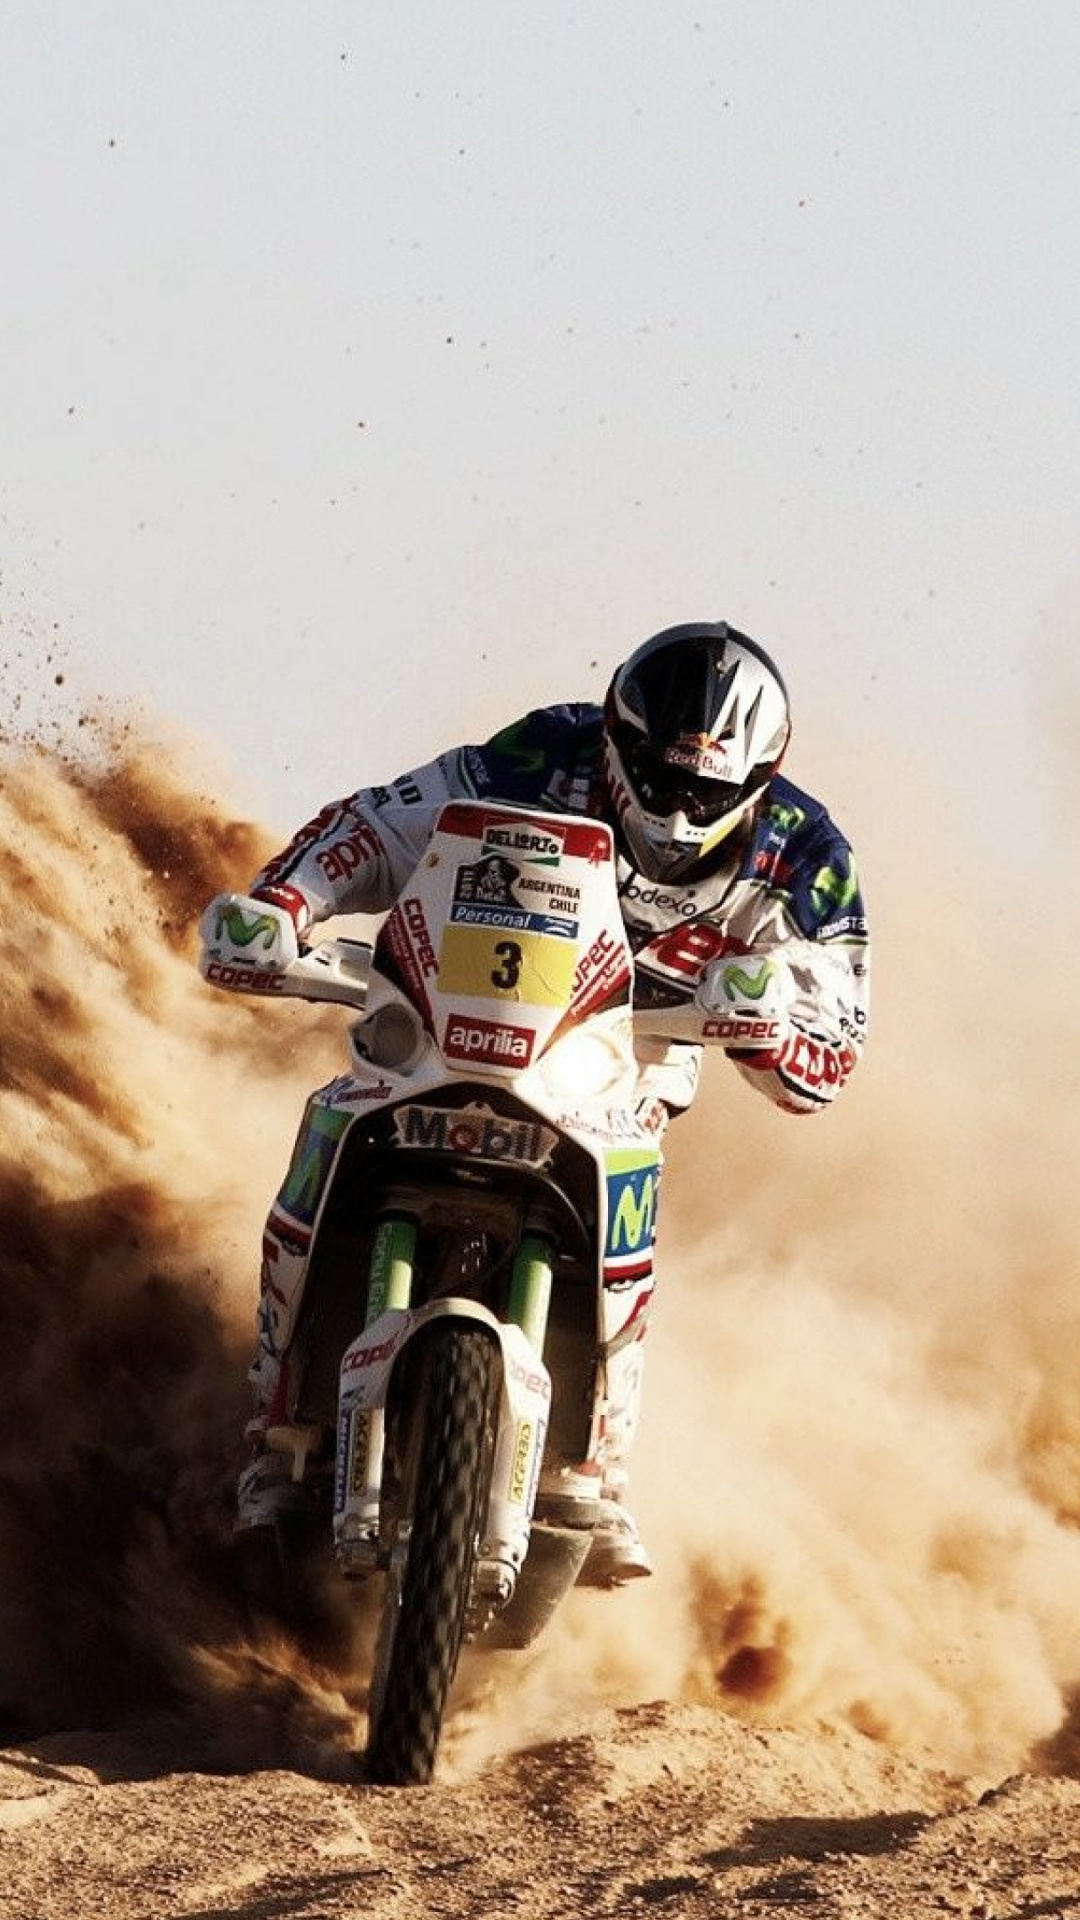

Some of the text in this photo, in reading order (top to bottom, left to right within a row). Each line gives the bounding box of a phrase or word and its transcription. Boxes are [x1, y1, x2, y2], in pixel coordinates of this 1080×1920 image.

[518, 878, 581, 899] ARGENTINA
[455, 906, 532, 929] Personal
[549, 899, 579, 914] CHILE
[491, 941, 523, 988] 3
[449, 1024, 530, 1059] aprilia
[403, 1105, 543, 1163] Mobil
